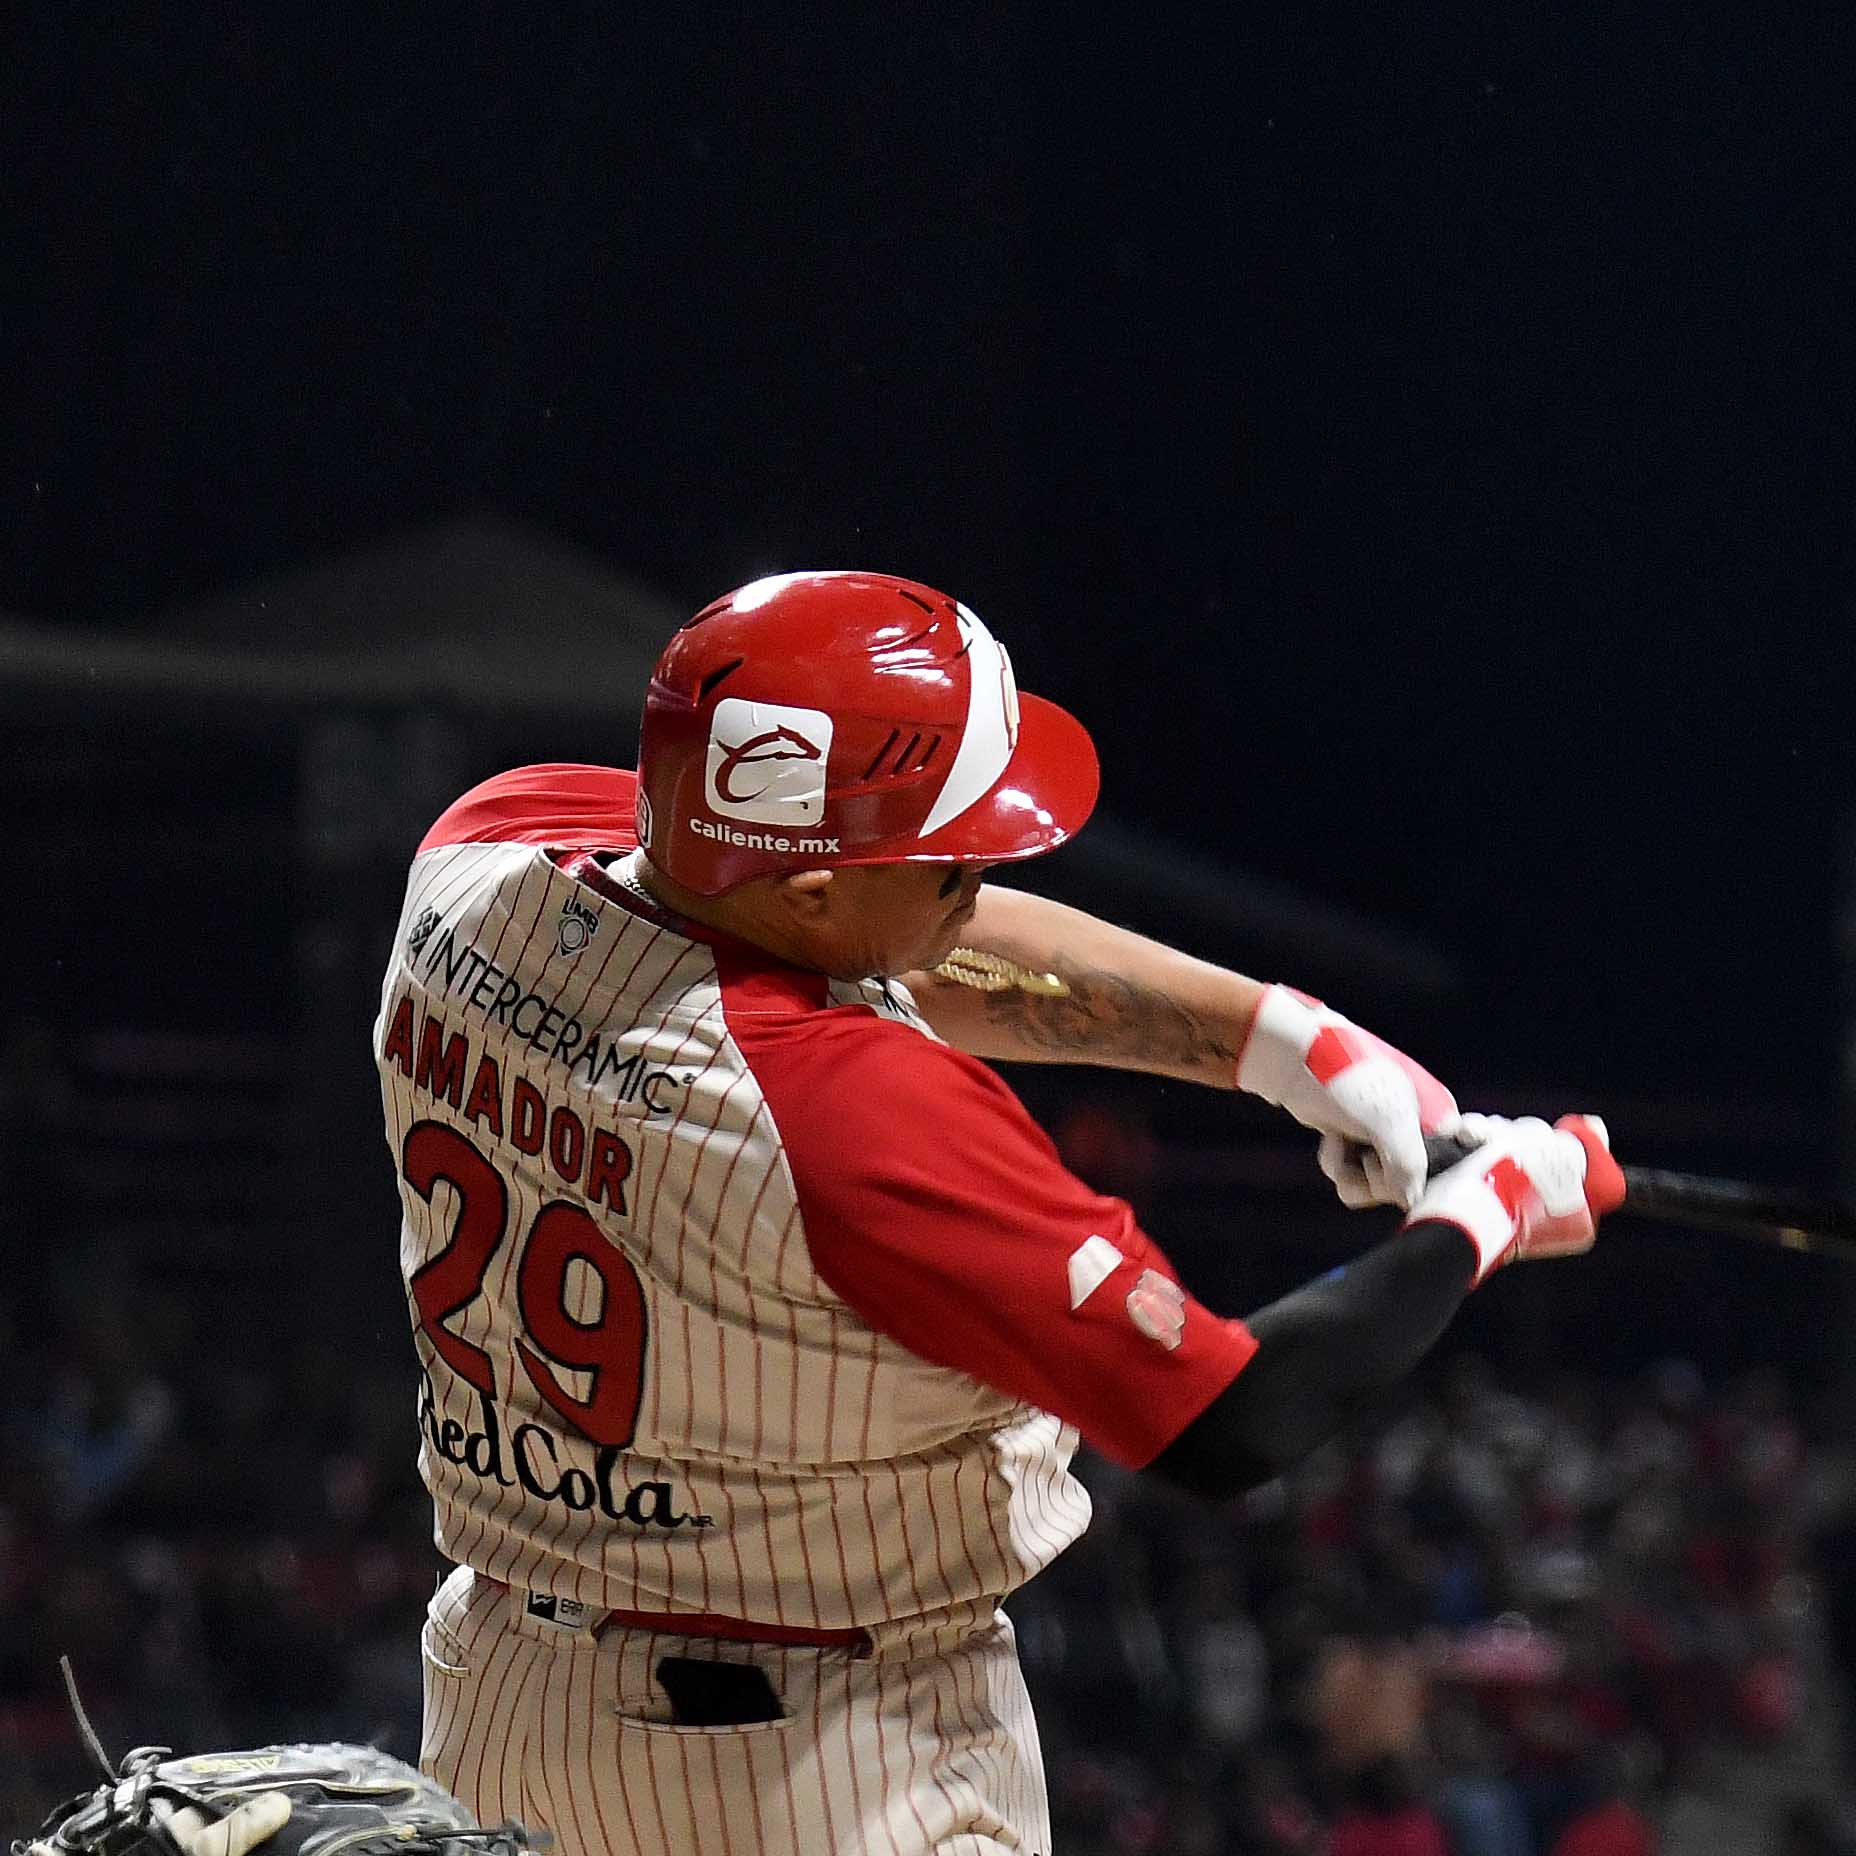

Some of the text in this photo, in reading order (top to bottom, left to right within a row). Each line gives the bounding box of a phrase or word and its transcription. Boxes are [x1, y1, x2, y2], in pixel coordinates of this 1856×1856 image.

[689, 816, 841, 855] caliente.mx
[384, 995, 633, 1217] AMADOR
[425, 926, 674, 1115] INTERCERAMIC
[402, 1118, 649, 1451] 29
[514, 1422, 688, 1528] Cola
